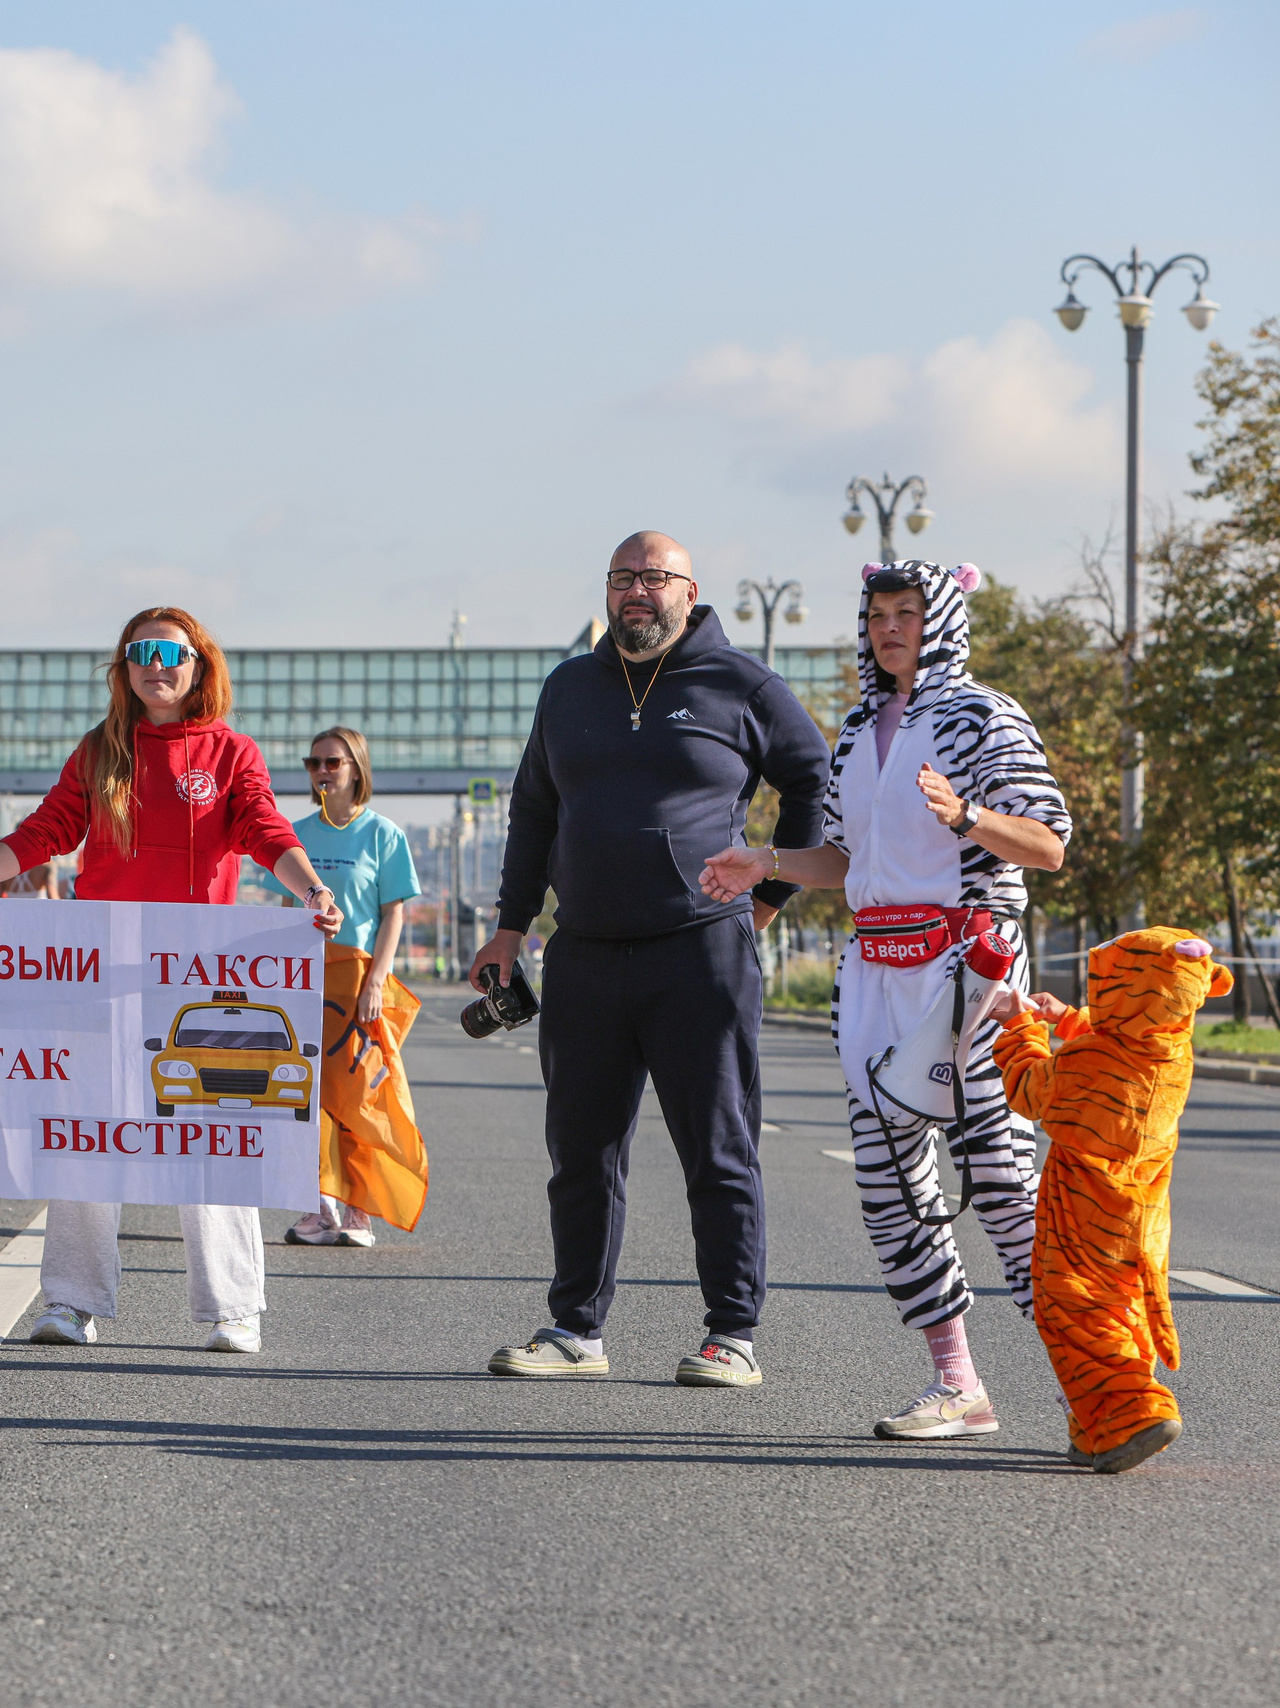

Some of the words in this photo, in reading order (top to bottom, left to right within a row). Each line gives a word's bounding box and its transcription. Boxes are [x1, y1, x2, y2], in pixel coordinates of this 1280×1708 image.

[180, 769, 203, 779] GODEN
[885, 914, 902, 922] утро
[864, 941, 875, 958] 5
[877, 940, 926, 961] вёрст
[150, 952, 315, 991] ТАКСИ
[38, 1117, 265, 1158] БЫСТРЕЕ
